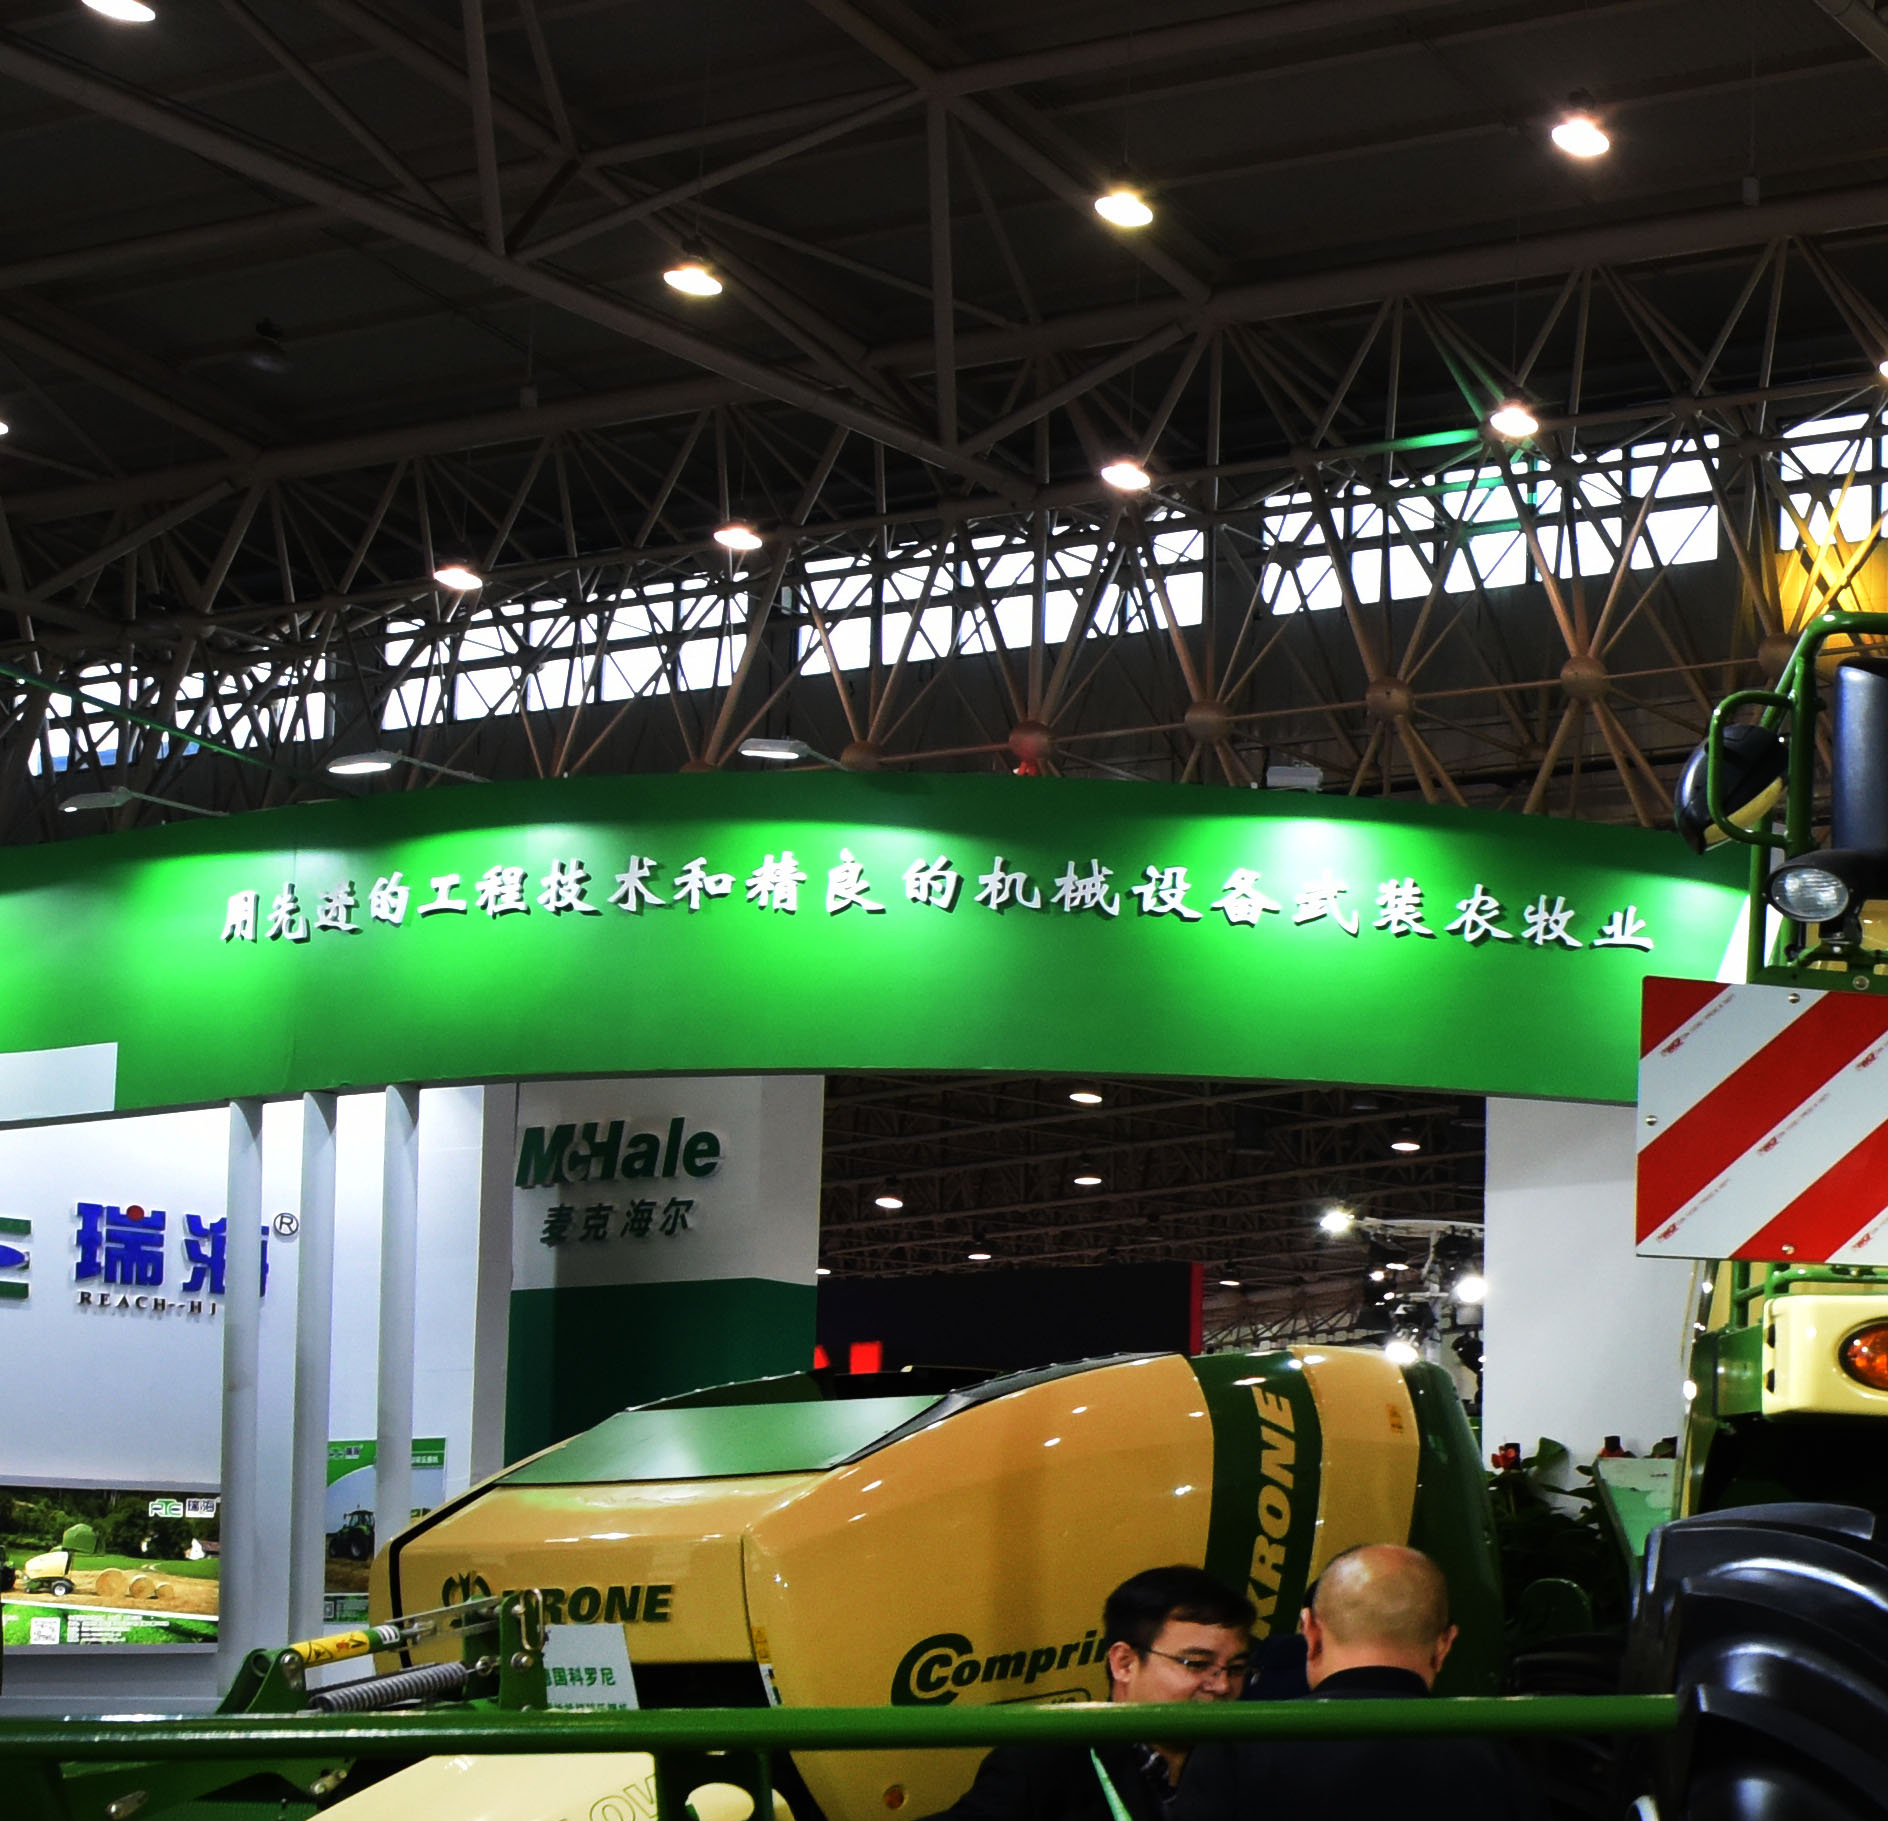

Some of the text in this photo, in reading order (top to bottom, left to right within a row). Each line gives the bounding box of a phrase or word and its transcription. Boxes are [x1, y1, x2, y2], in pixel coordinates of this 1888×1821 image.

[220, 848, 1655, 952] 用先进的工程技术和精良的机械设备武装农牧业
[515, 1117, 720, 1187] McHale
[540, 1197, 694, 1248] 麦克海尔
[1247, 1385, 1296, 1641] KRONE
[891, 1630, 1108, 1706] Compri
